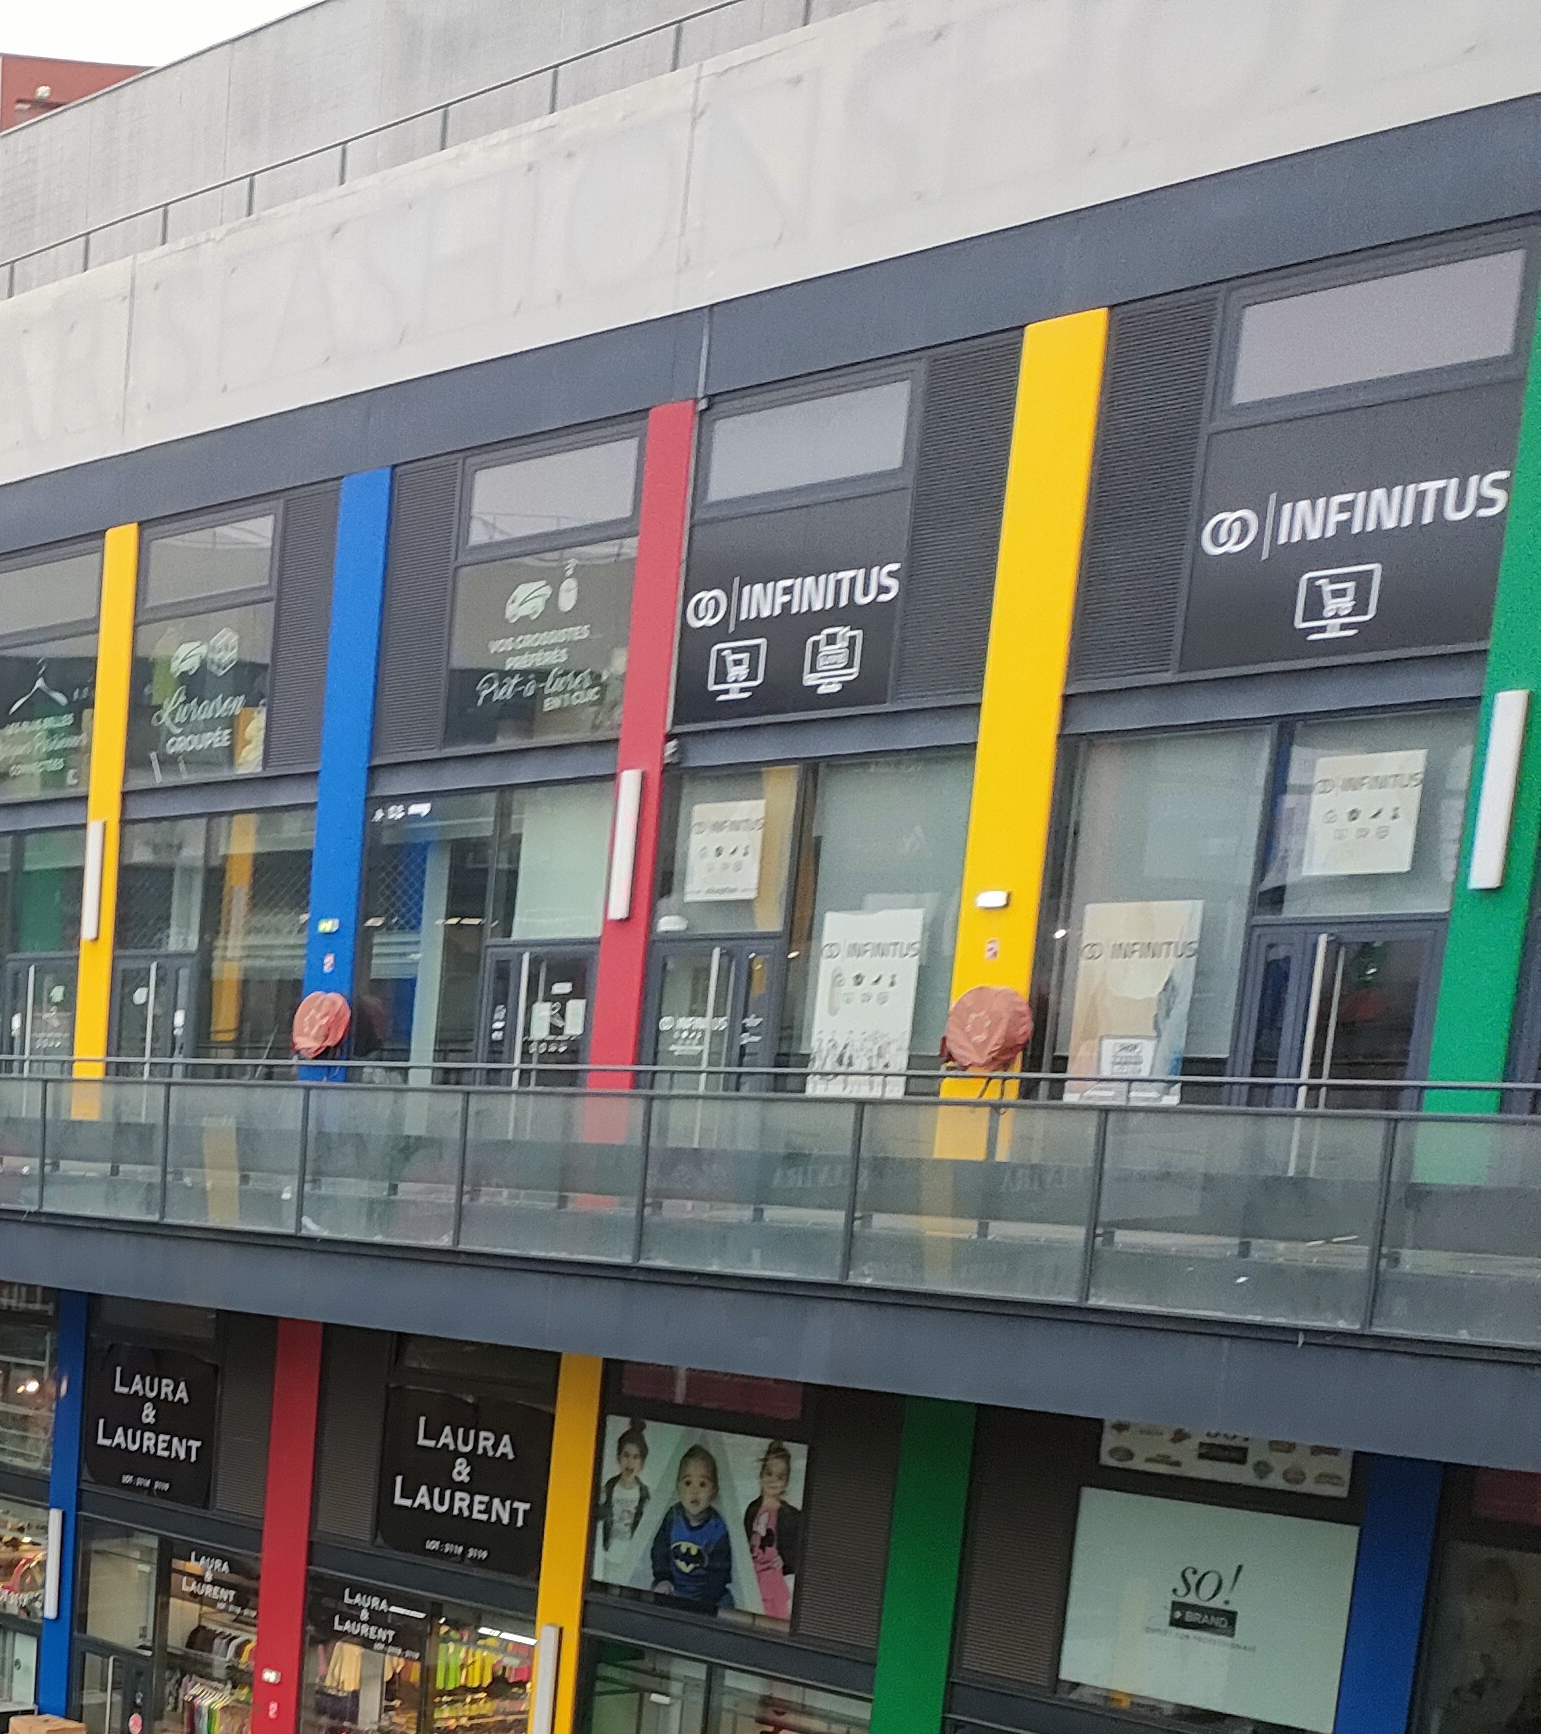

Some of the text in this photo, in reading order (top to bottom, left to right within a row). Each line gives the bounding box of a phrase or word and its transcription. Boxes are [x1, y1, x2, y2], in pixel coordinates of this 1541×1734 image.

[1277, 470, 1510, 544] INFINITUS
[741, 562, 902, 620] INFINITUS
[846, 942, 921, 959] INFINITUS
[1110, 940, 1199, 960] INFINITUS
[114, 1366, 189, 1404] LAURA
[141, 1402, 156, 1424] &
[97, 1418, 202, 1463] LAURENT
[417, 1416, 515, 1460] LAURA
[452, 1457, 471, 1483] &
[393, 1475, 531, 1528] LAURENT
[191, 1551, 230, 1573] LAURA
[181, 1576, 237, 1603] LAURENT
[344, 1587, 389, 1613] LAURA
[334, 1614, 396, 1643] LAURENT
[1185, 1611, 1228, 1629] BRAND
